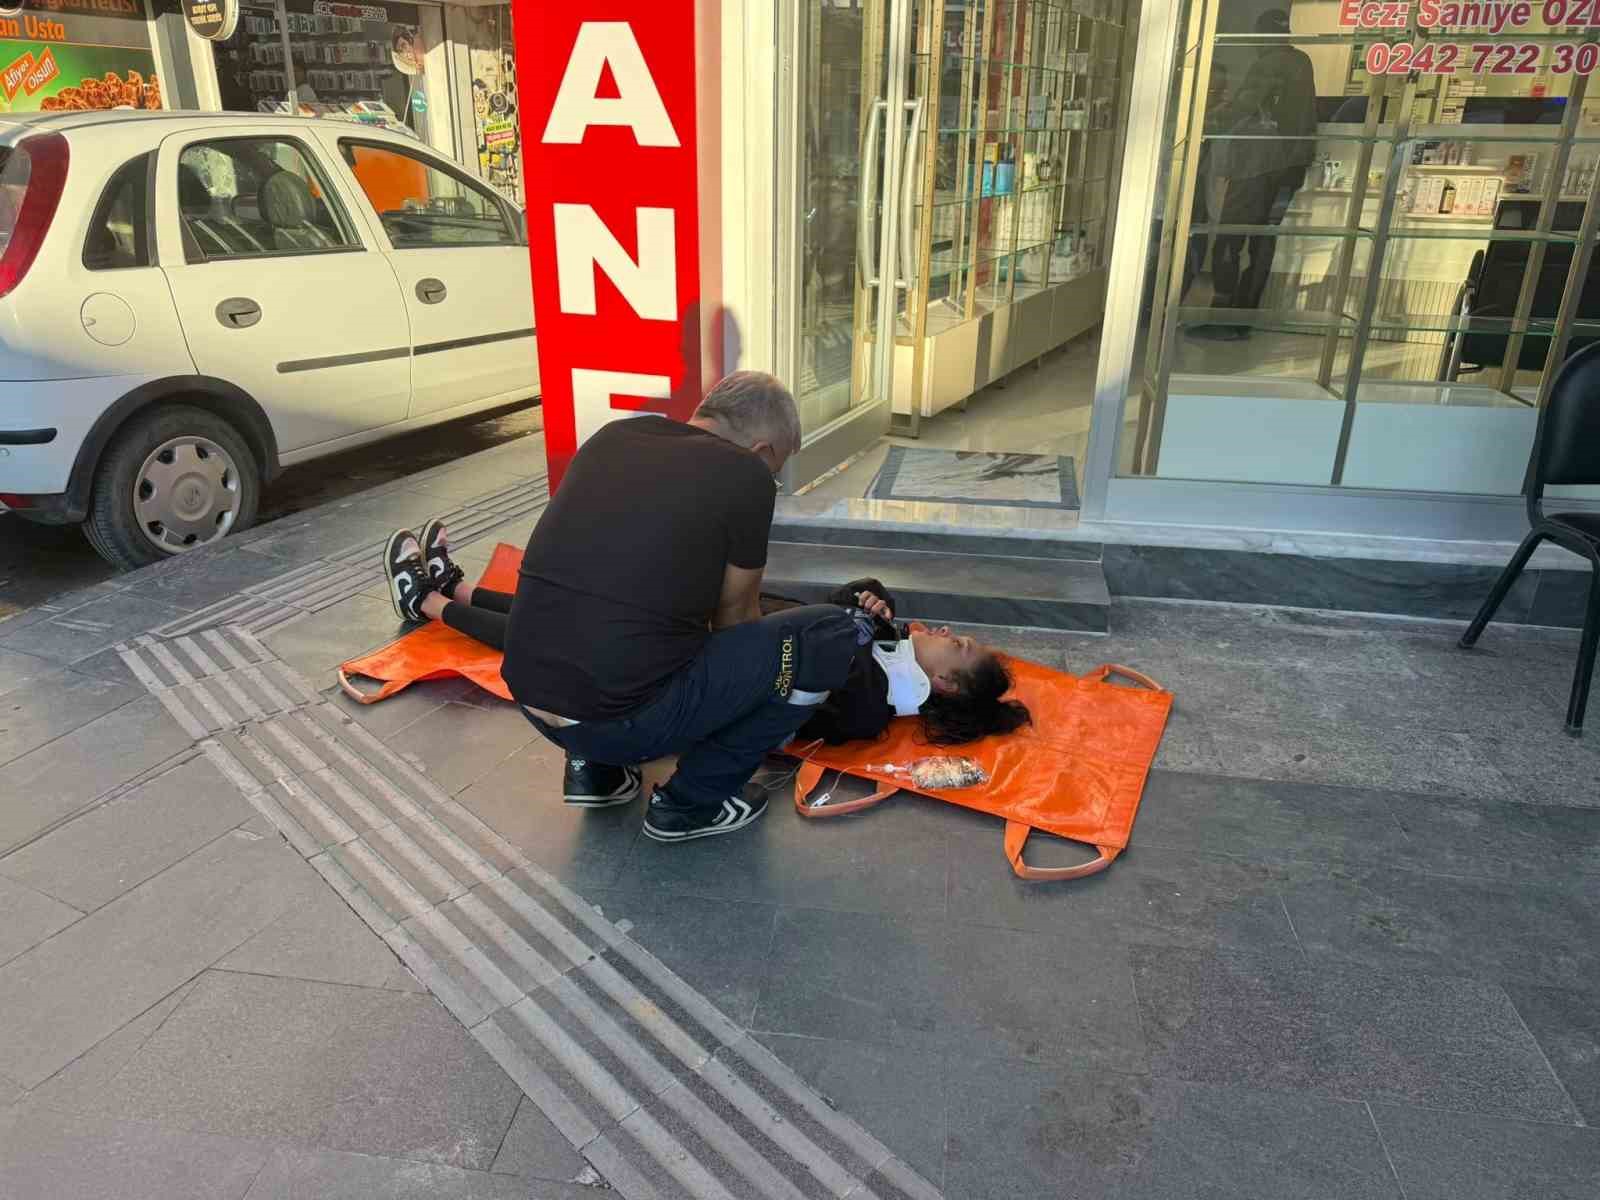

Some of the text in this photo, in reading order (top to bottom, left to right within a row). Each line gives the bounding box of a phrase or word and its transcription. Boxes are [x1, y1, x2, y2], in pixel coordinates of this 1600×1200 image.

[24, 15, 64, 40] Usta
[1416, 0, 1531, 36] Saniye
[1366, 43, 1598, 75] 0242 722 30
[780, 634, 793, 697] CONTROL
